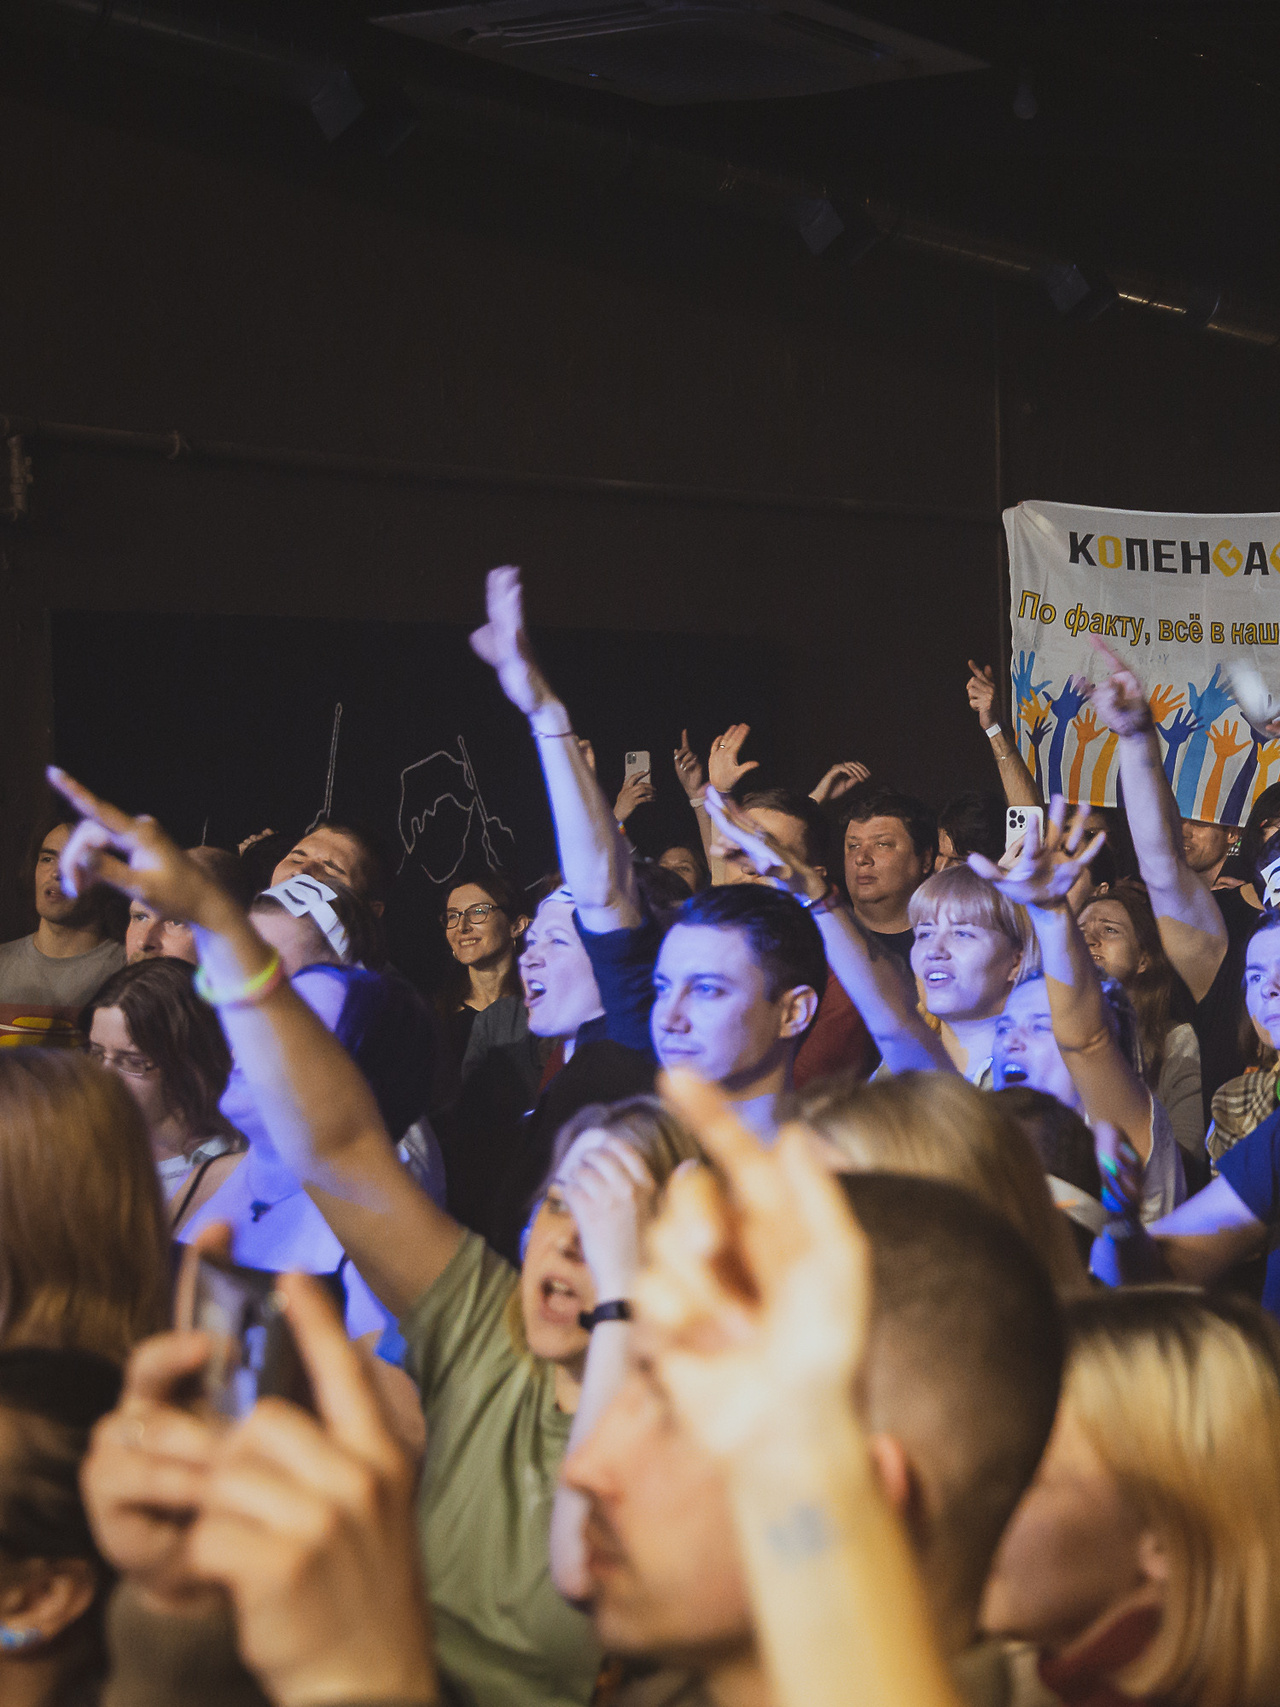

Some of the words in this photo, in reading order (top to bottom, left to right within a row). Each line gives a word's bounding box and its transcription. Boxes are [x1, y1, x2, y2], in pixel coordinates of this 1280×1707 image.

[1017, 589, 1057, 625] По
[1063, 602, 1151, 647] факту,
[1158, 612, 1204, 643] всё
[1210, 621, 1225, 644] в
